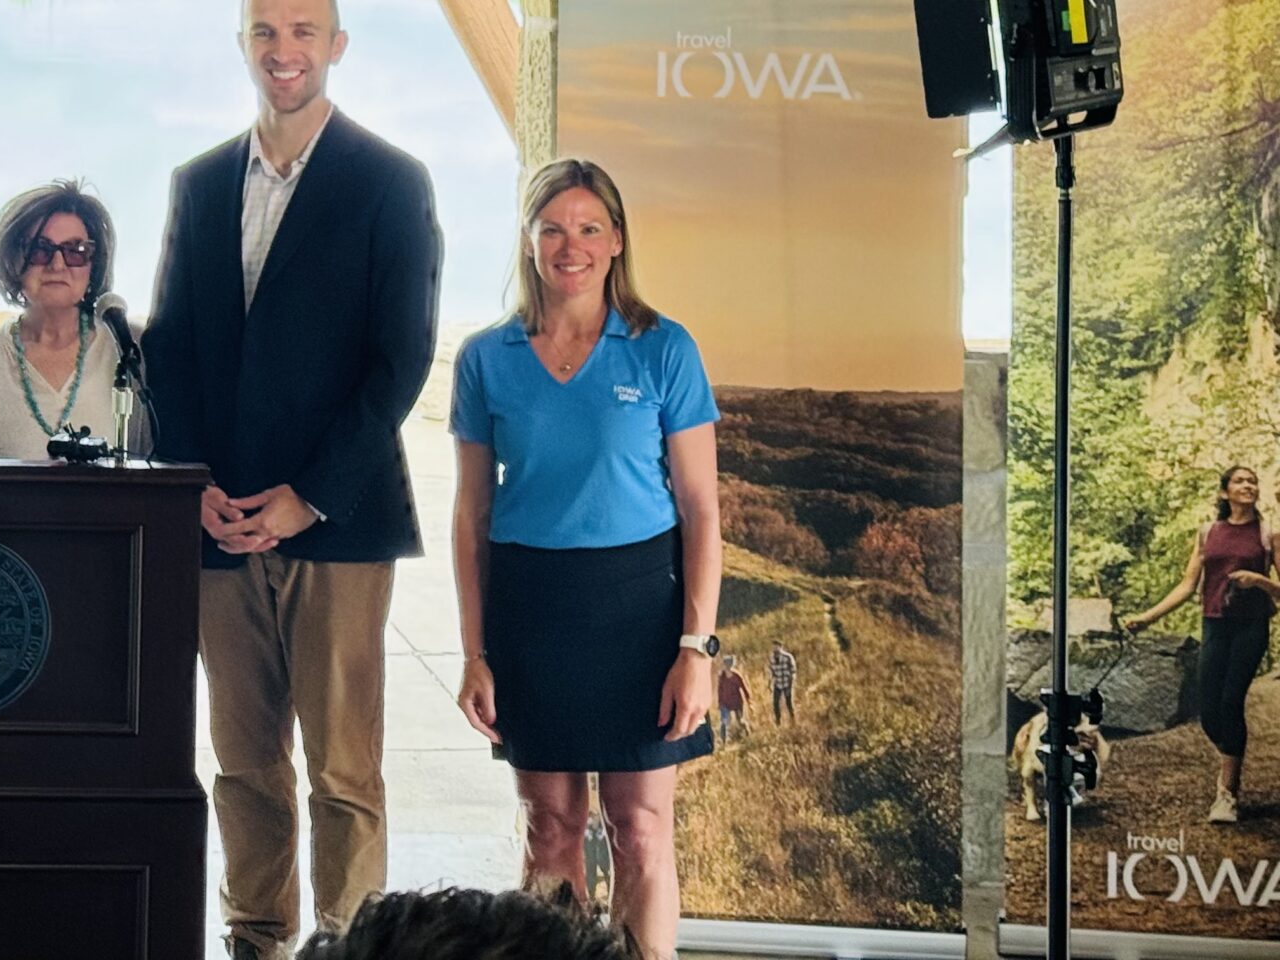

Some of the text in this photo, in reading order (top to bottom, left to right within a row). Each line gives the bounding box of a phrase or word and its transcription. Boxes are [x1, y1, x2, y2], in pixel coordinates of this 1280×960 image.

[676, 26, 732, 49] travel
[656, 50, 854, 100] IOWA
[1126, 828, 1185, 853] travel
